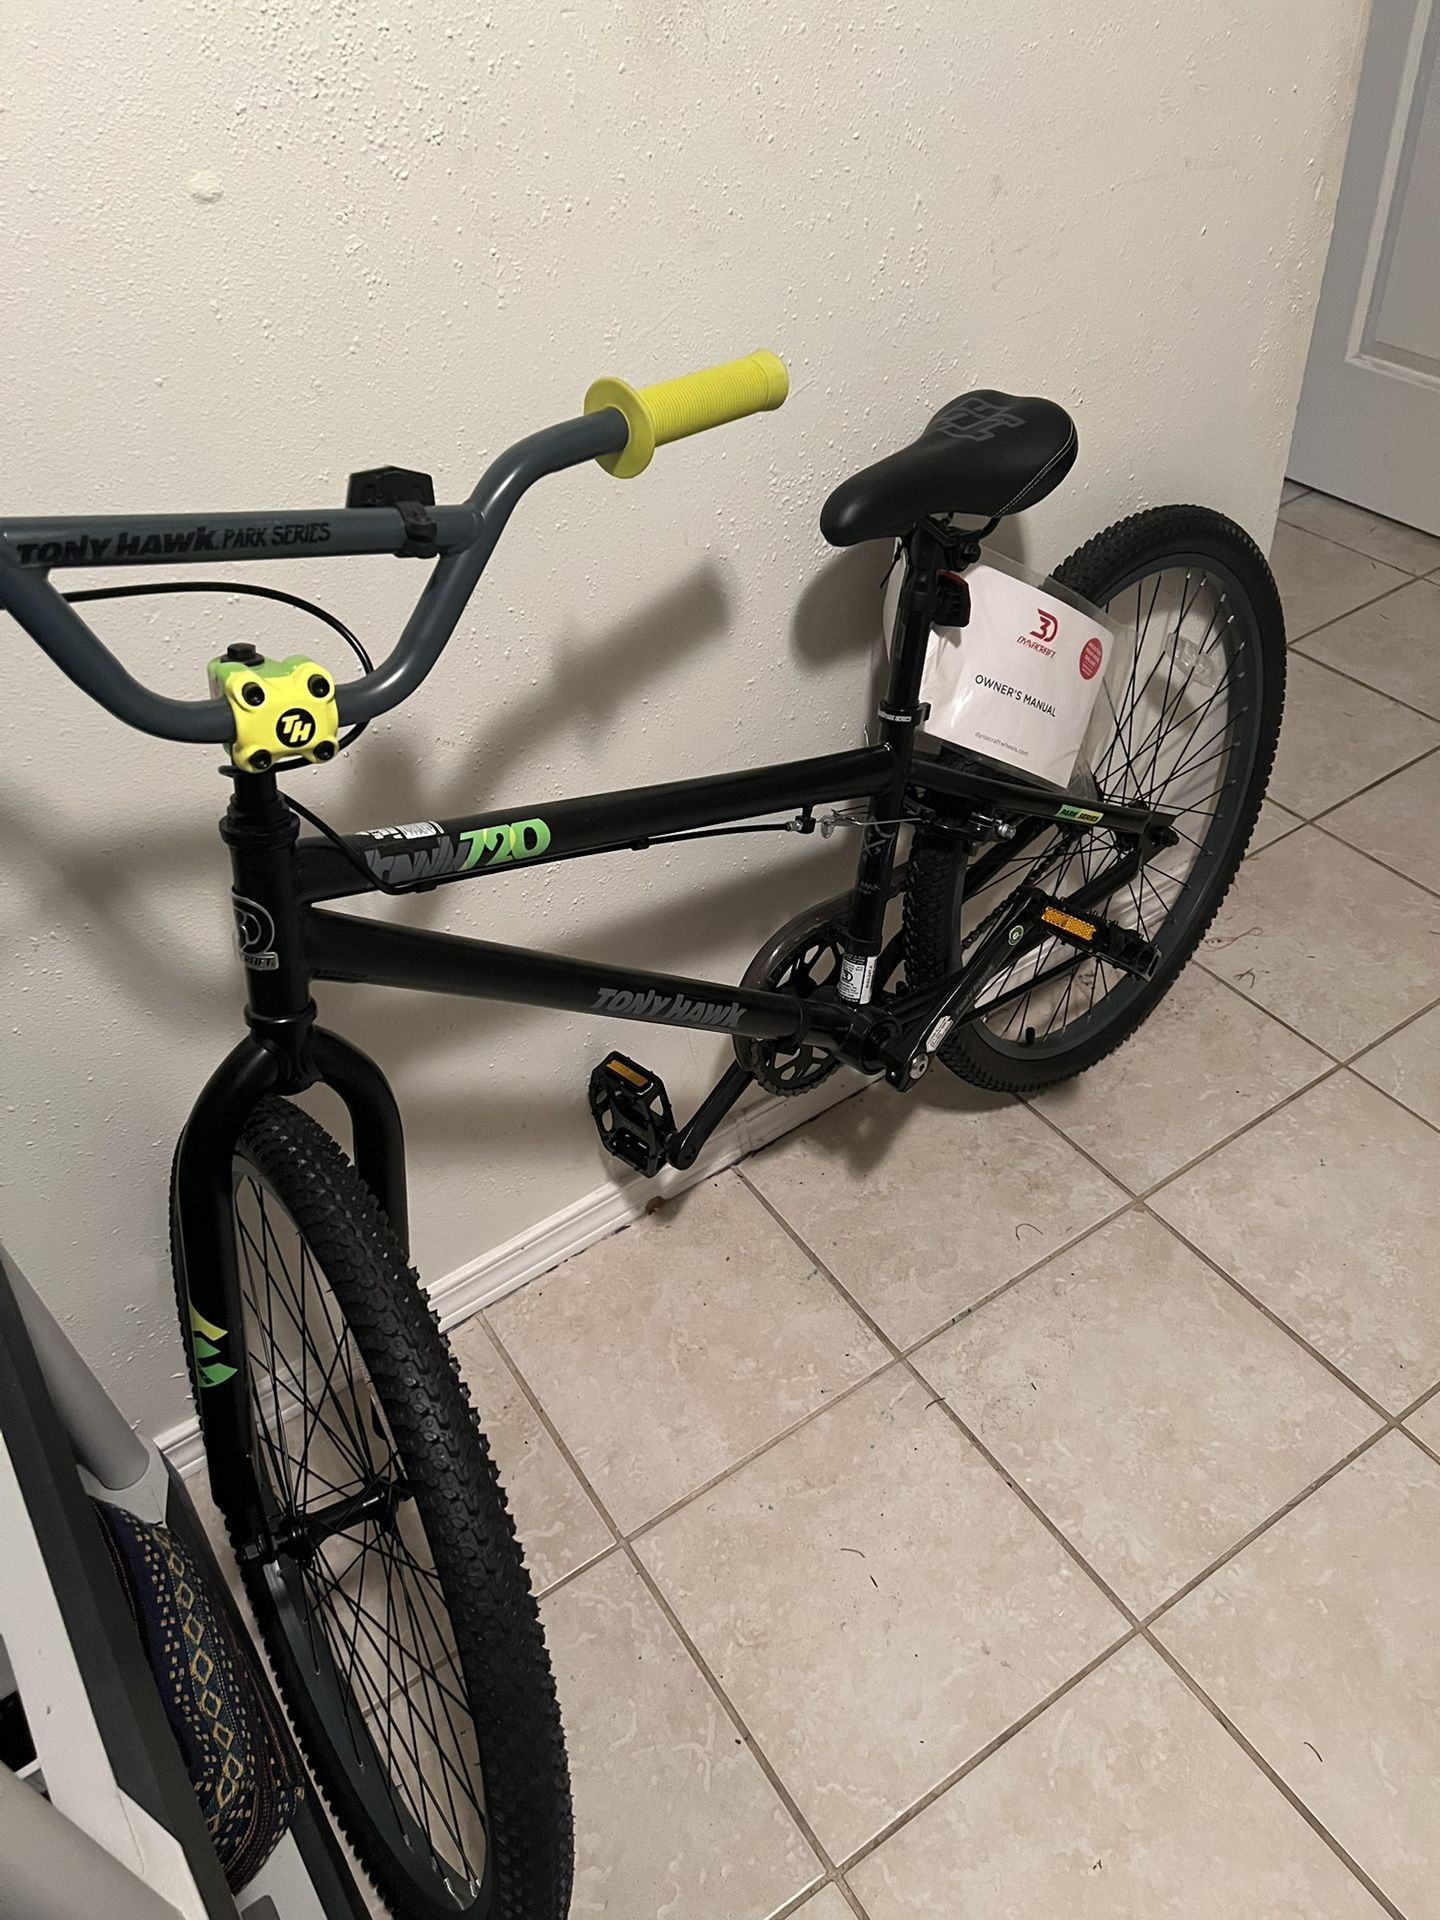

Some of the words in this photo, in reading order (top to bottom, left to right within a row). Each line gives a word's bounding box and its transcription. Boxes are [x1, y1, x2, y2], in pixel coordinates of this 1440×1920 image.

[17, 535, 111, 566] TONY
[223, 528, 267, 548] PARK
[271, 523, 331, 545] SERIES
[975, 674, 1022, 701] OWNER'S
[1022, 693, 1056, 718] MANUAL
[281, 714, 312, 743] TH
[459, 817, 551, 871] 720
[591, 987, 673, 1017] TONY
[661, 993, 748, 1027] HAWK
